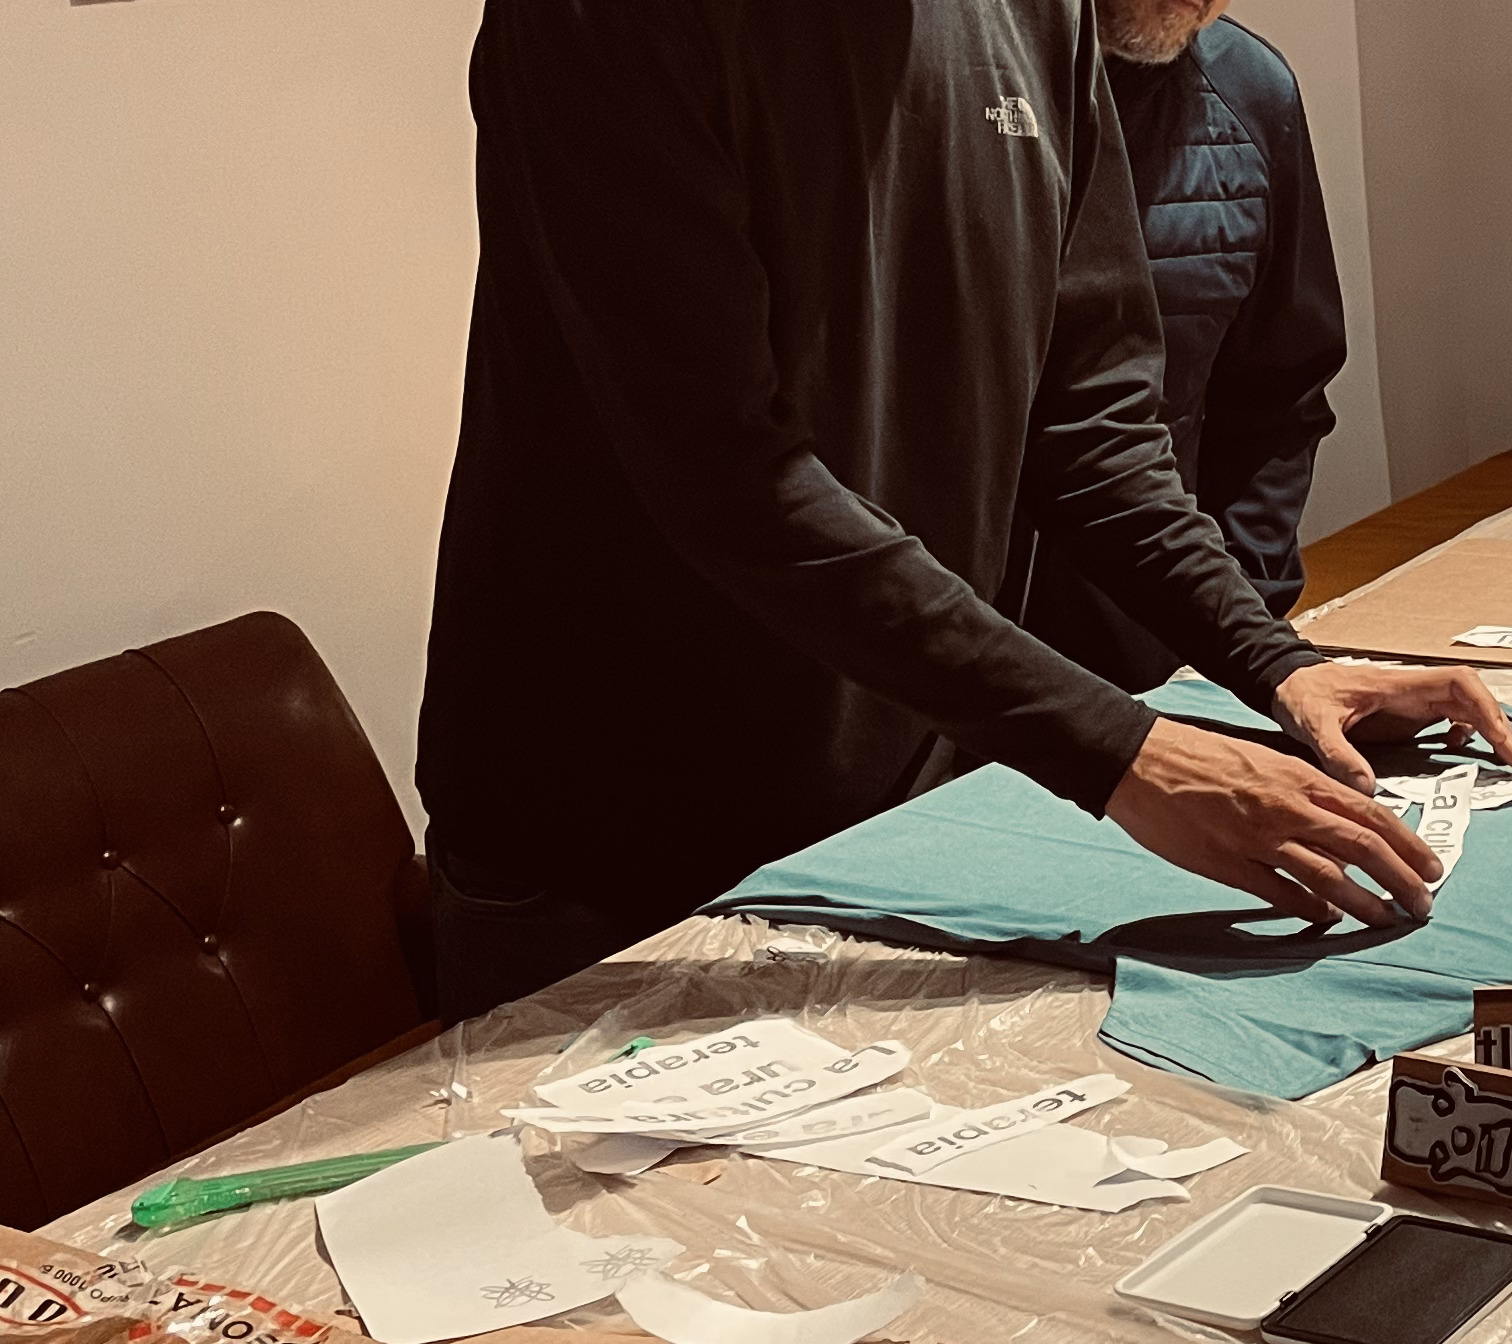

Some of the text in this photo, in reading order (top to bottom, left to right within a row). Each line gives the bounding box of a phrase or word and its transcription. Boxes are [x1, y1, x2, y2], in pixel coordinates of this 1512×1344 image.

[1431, 772, 1468, 811] La
[577, 1035, 761, 1098] terapia
[822, 1044, 896, 1076] La
[906, 1088, 1087, 1159] terapia
